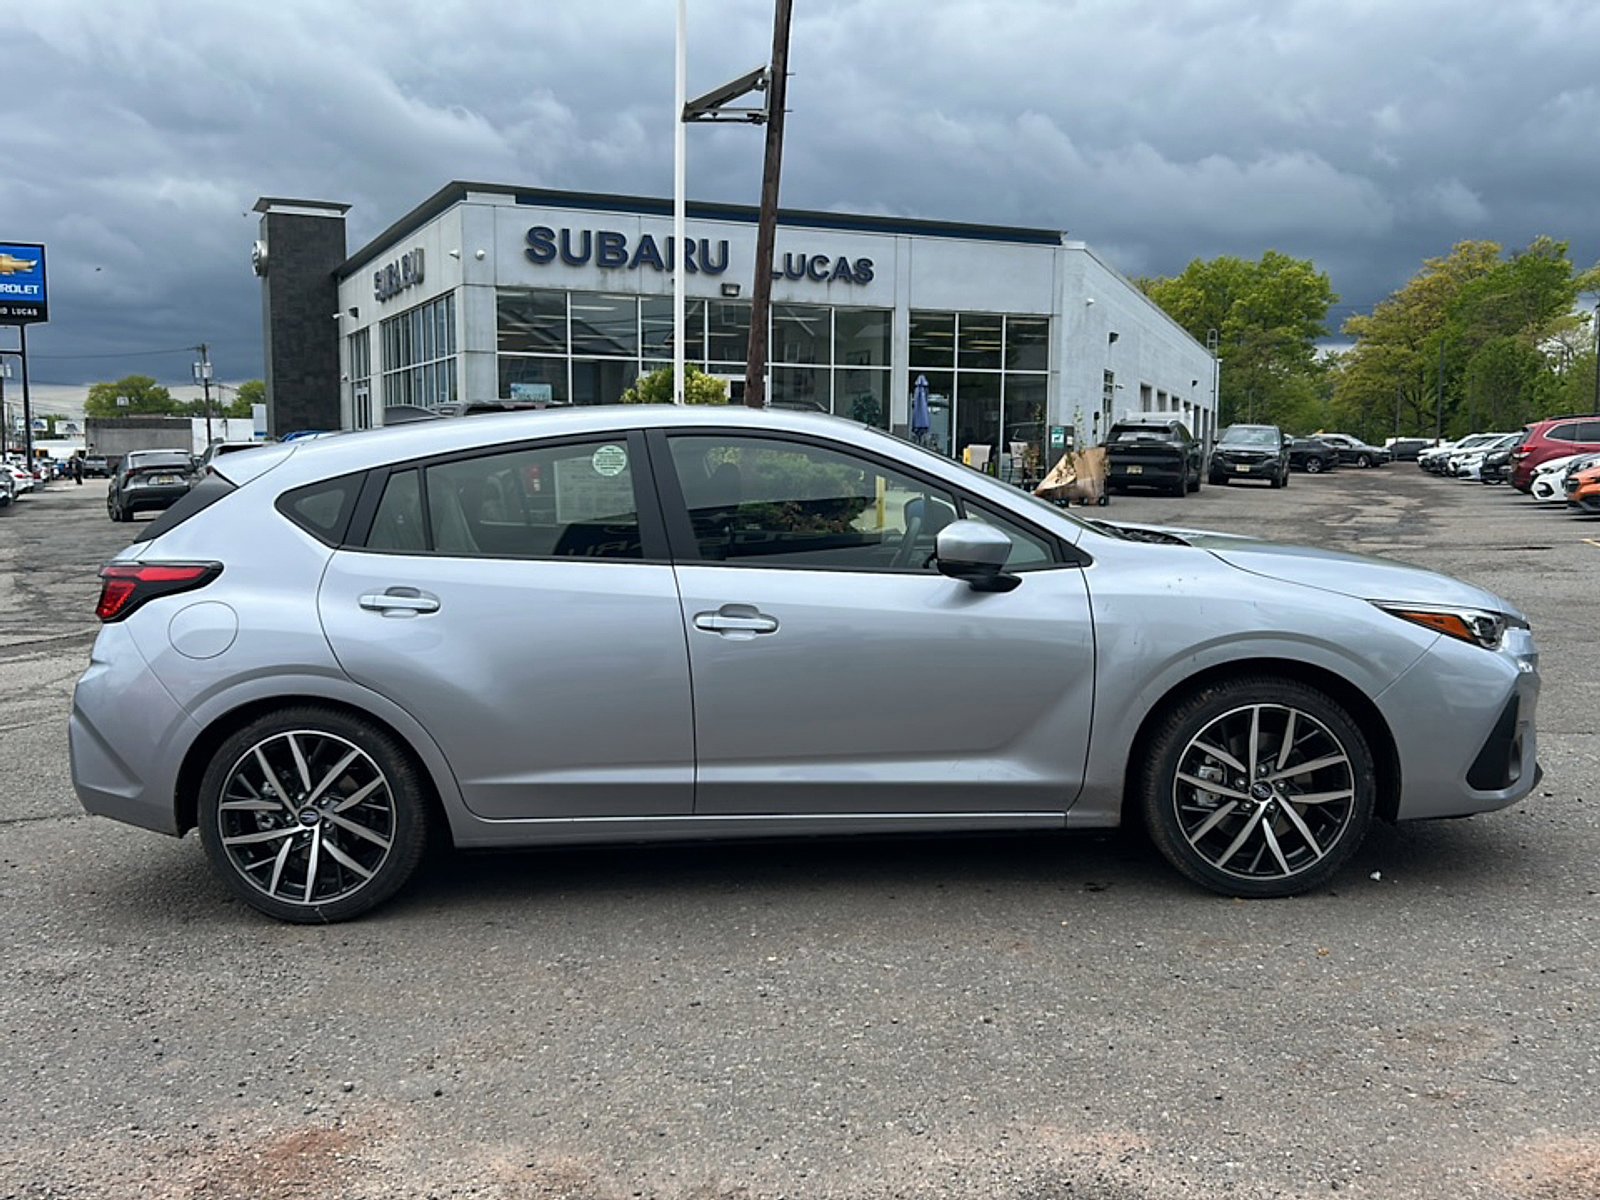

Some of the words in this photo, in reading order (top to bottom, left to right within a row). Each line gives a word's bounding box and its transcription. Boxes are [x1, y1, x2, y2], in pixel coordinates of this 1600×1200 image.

[374, 247, 424, 302] SUBARU
[525, 226, 729, 275] SUBARU
[11, 307, 38, 316] LUCAS
